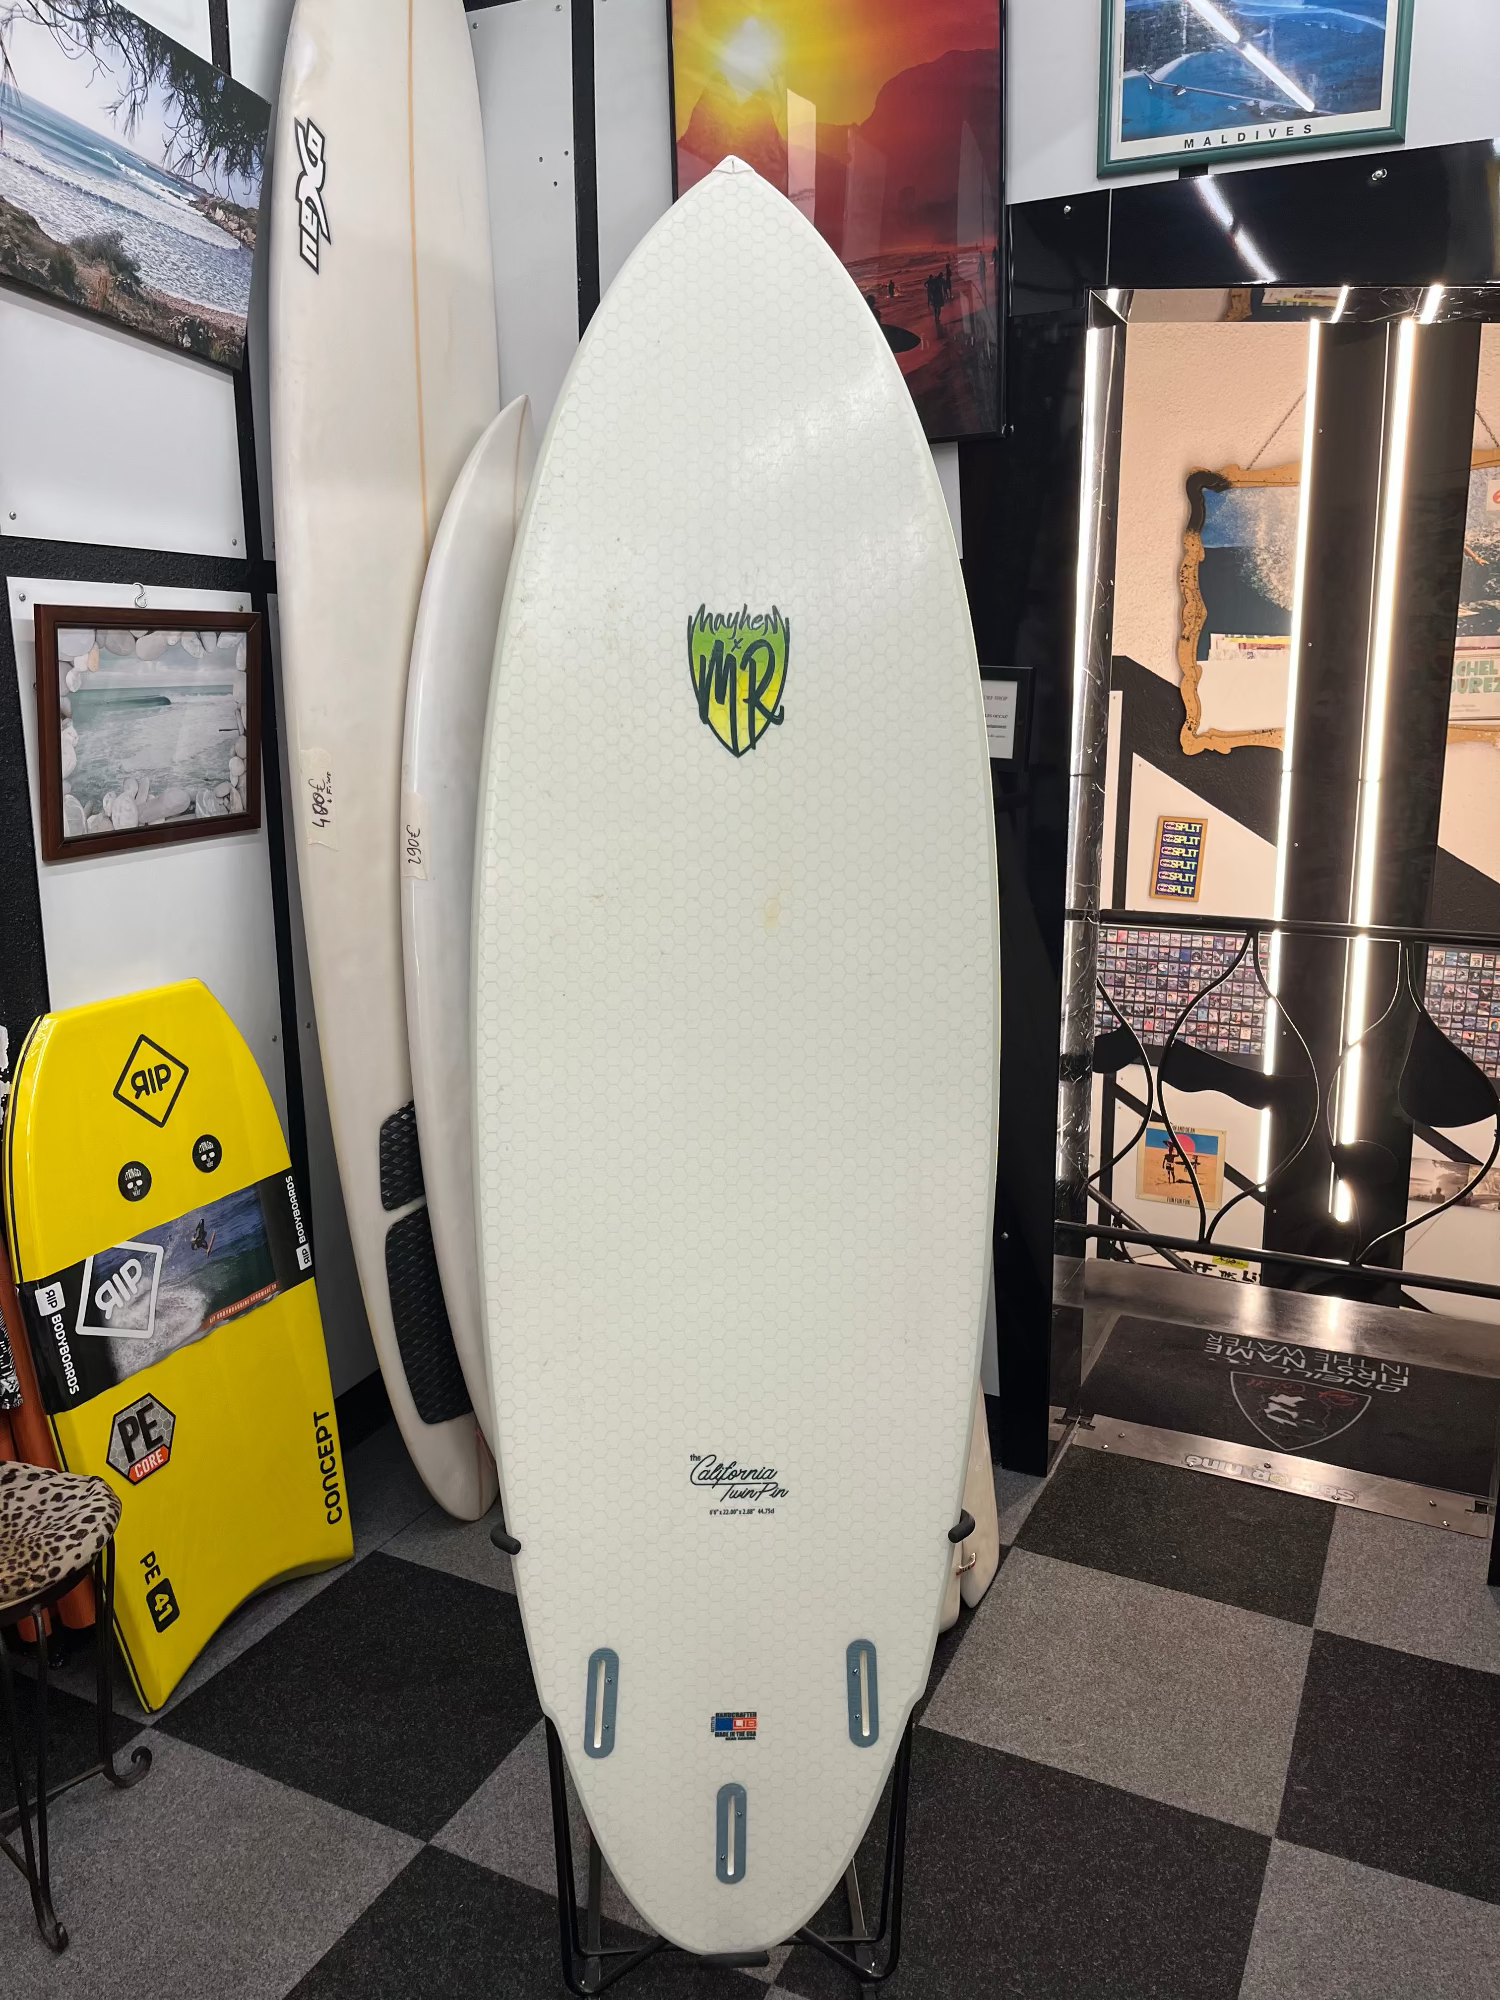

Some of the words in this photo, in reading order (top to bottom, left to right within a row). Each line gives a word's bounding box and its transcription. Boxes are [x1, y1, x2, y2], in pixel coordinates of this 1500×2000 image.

[1184, 124, 1312, 149] MALDIVES
[1456, 660, 1498, 676] CHEL
[1452, 677, 1500, 694] UREZ
[406, 825, 421, 865] 290€
[131, 1064, 171, 1099] RIP
[285, 1175, 306, 1244] BODYBOARDS
[45, 1289, 58, 1309] RIP
[94, 1258, 142, 1320] RIP
[51, 1313, 79, 1395] BODYBOARDS
[1204, 1344, 1305, 1369] NAME
[1206, 1334, 1305, 1358] WATER
[1314, 1352, 1367, 1368] THE
[1315, 1363, 1409, 1387] FIRST
[1380, 1362, 1409, 1376] IN
[117, 1402, 163, 1464] PE
[134, 1449, 164, 1478] CORE
[313, 1411, 343, 1525] CONCEPT
[690, 1454, 778, 1489] California
[140, 1551, 161, 1585] PE
[154, 1592, 173, 1622] 41
